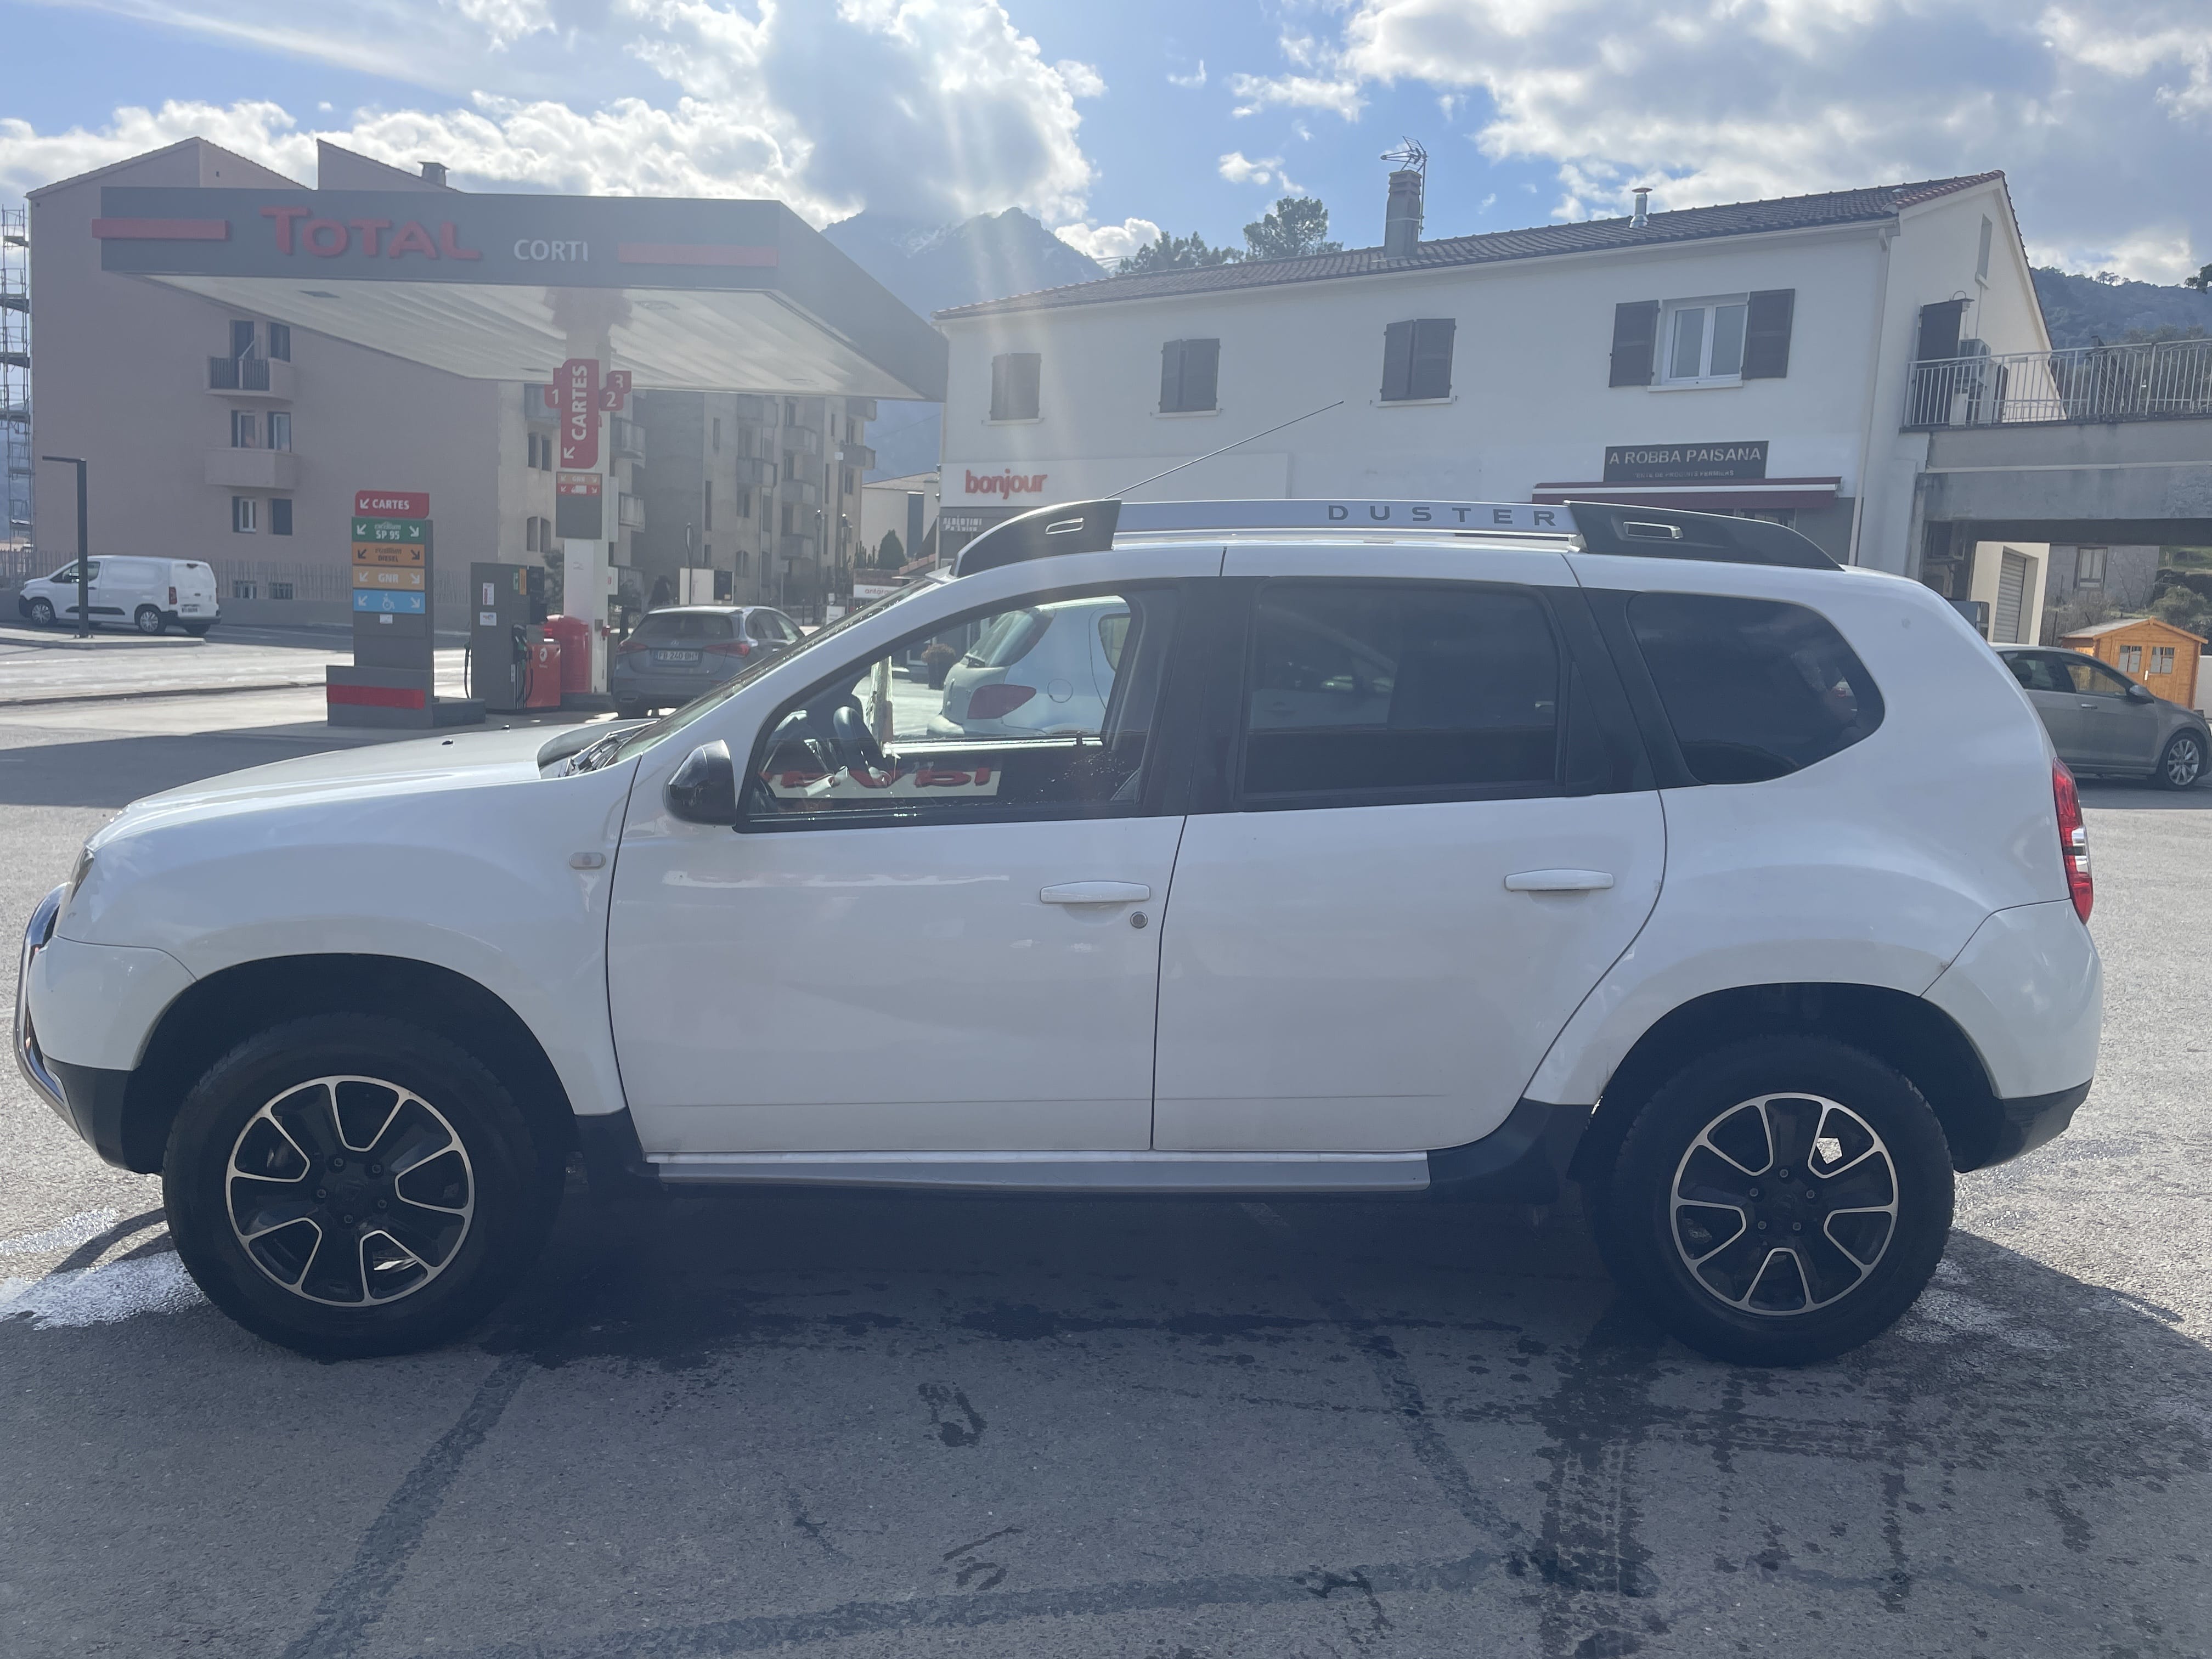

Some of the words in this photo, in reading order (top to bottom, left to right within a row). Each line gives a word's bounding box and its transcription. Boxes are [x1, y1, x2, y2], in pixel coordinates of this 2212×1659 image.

[259, 206, 482, 261] TOTAL
[514, 239, 589, 262] CORTI
[614, 374, 624, 387] 3
[552, 389, 559, 404] 1
[572, 365, 587, 441] CARTES
[606, 391, 617, 408] 2
[1609, 452, 1620, 465] A
[1624, 450, 1681, 464] ROBBA
[1686, 447, 1762, 462] PAISANA
[965, 469, 1048, 500] bonjour
[372, 498, 410, 510] CARTES
[1328, 505, 1556, 527] DUSTER
[376, 530, 387, 540] SP
[390, 530, 400, 540] 95
[378, 573, 399, 583] GNR
